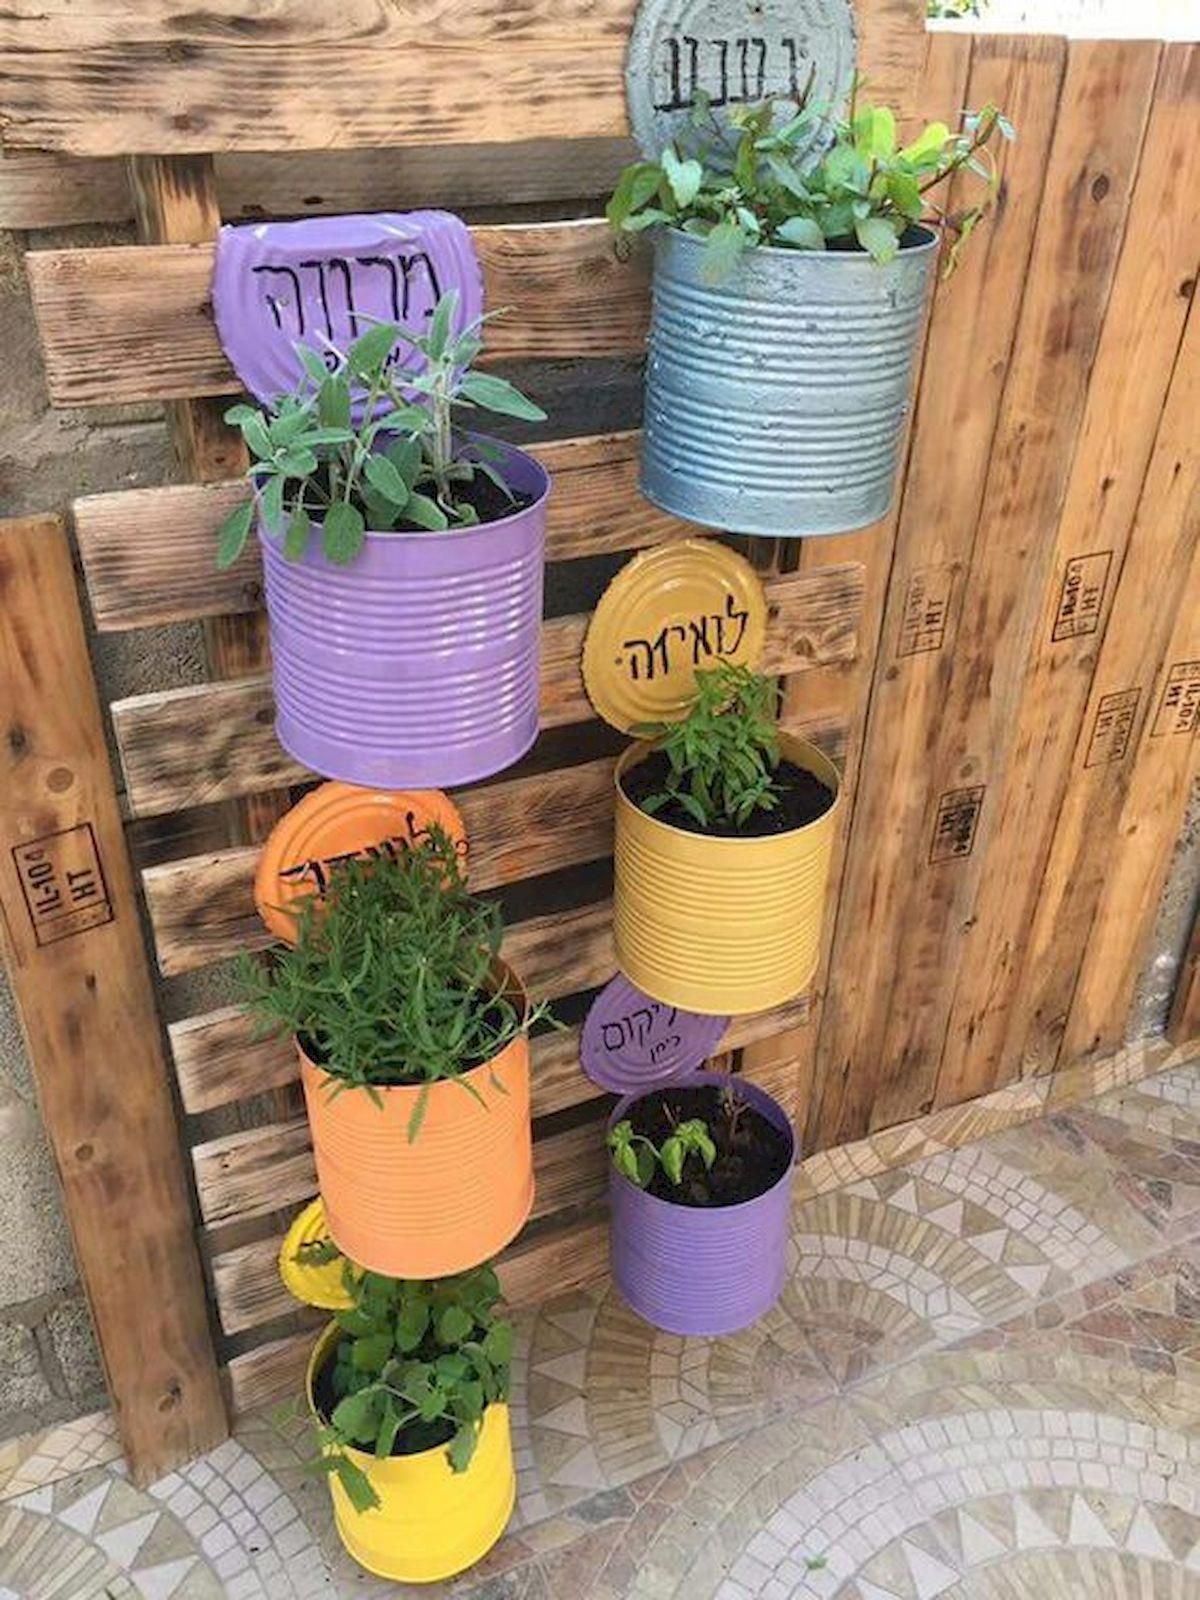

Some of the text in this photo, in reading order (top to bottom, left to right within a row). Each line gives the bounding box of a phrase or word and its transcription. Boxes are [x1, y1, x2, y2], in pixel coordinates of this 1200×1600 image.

[1081, 587, 1099, 612] HT
[623, 594, 750, 680] לואיזה
[1166, 685, 1183, 706] HT
[66, 868, 97, 903] HT
